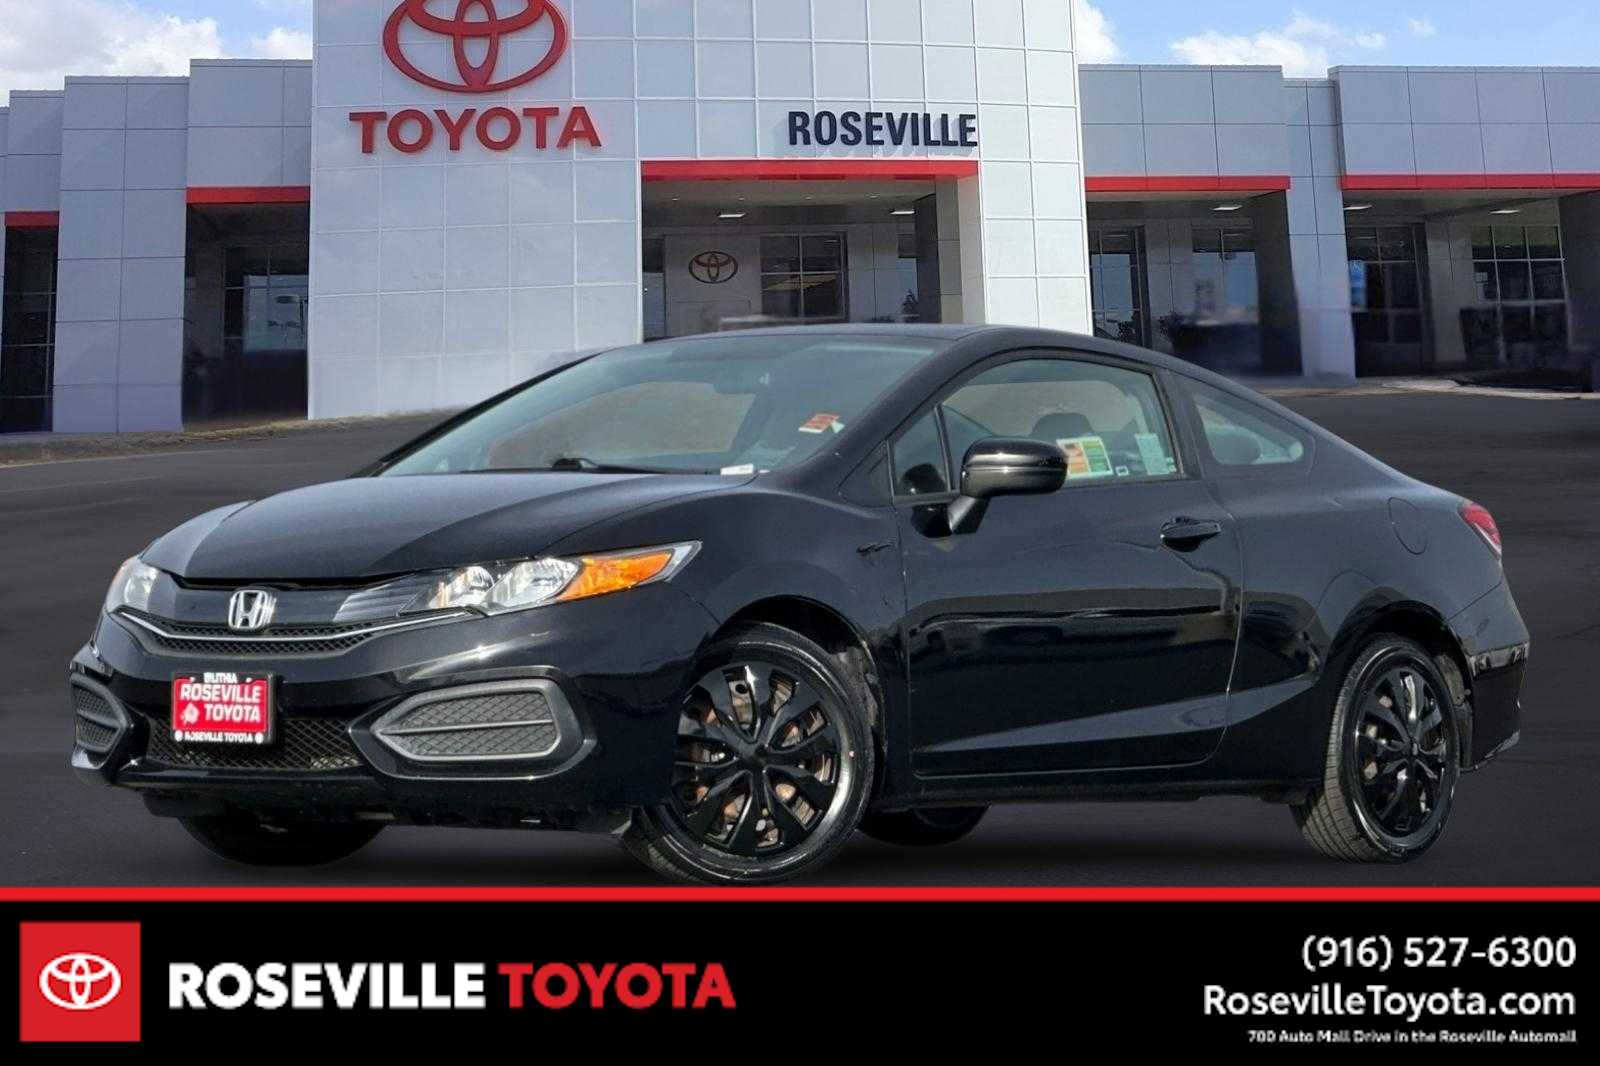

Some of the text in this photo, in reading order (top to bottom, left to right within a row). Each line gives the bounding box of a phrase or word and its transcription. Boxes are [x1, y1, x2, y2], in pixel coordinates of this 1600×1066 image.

[349, 106, 602, 154] TOYOTA
[788, 111, 978, 147] ROSEVILLE
[180, 683, 262, 703] ROSEVILLE
[204, 703, 261, 722] TOYOTA
